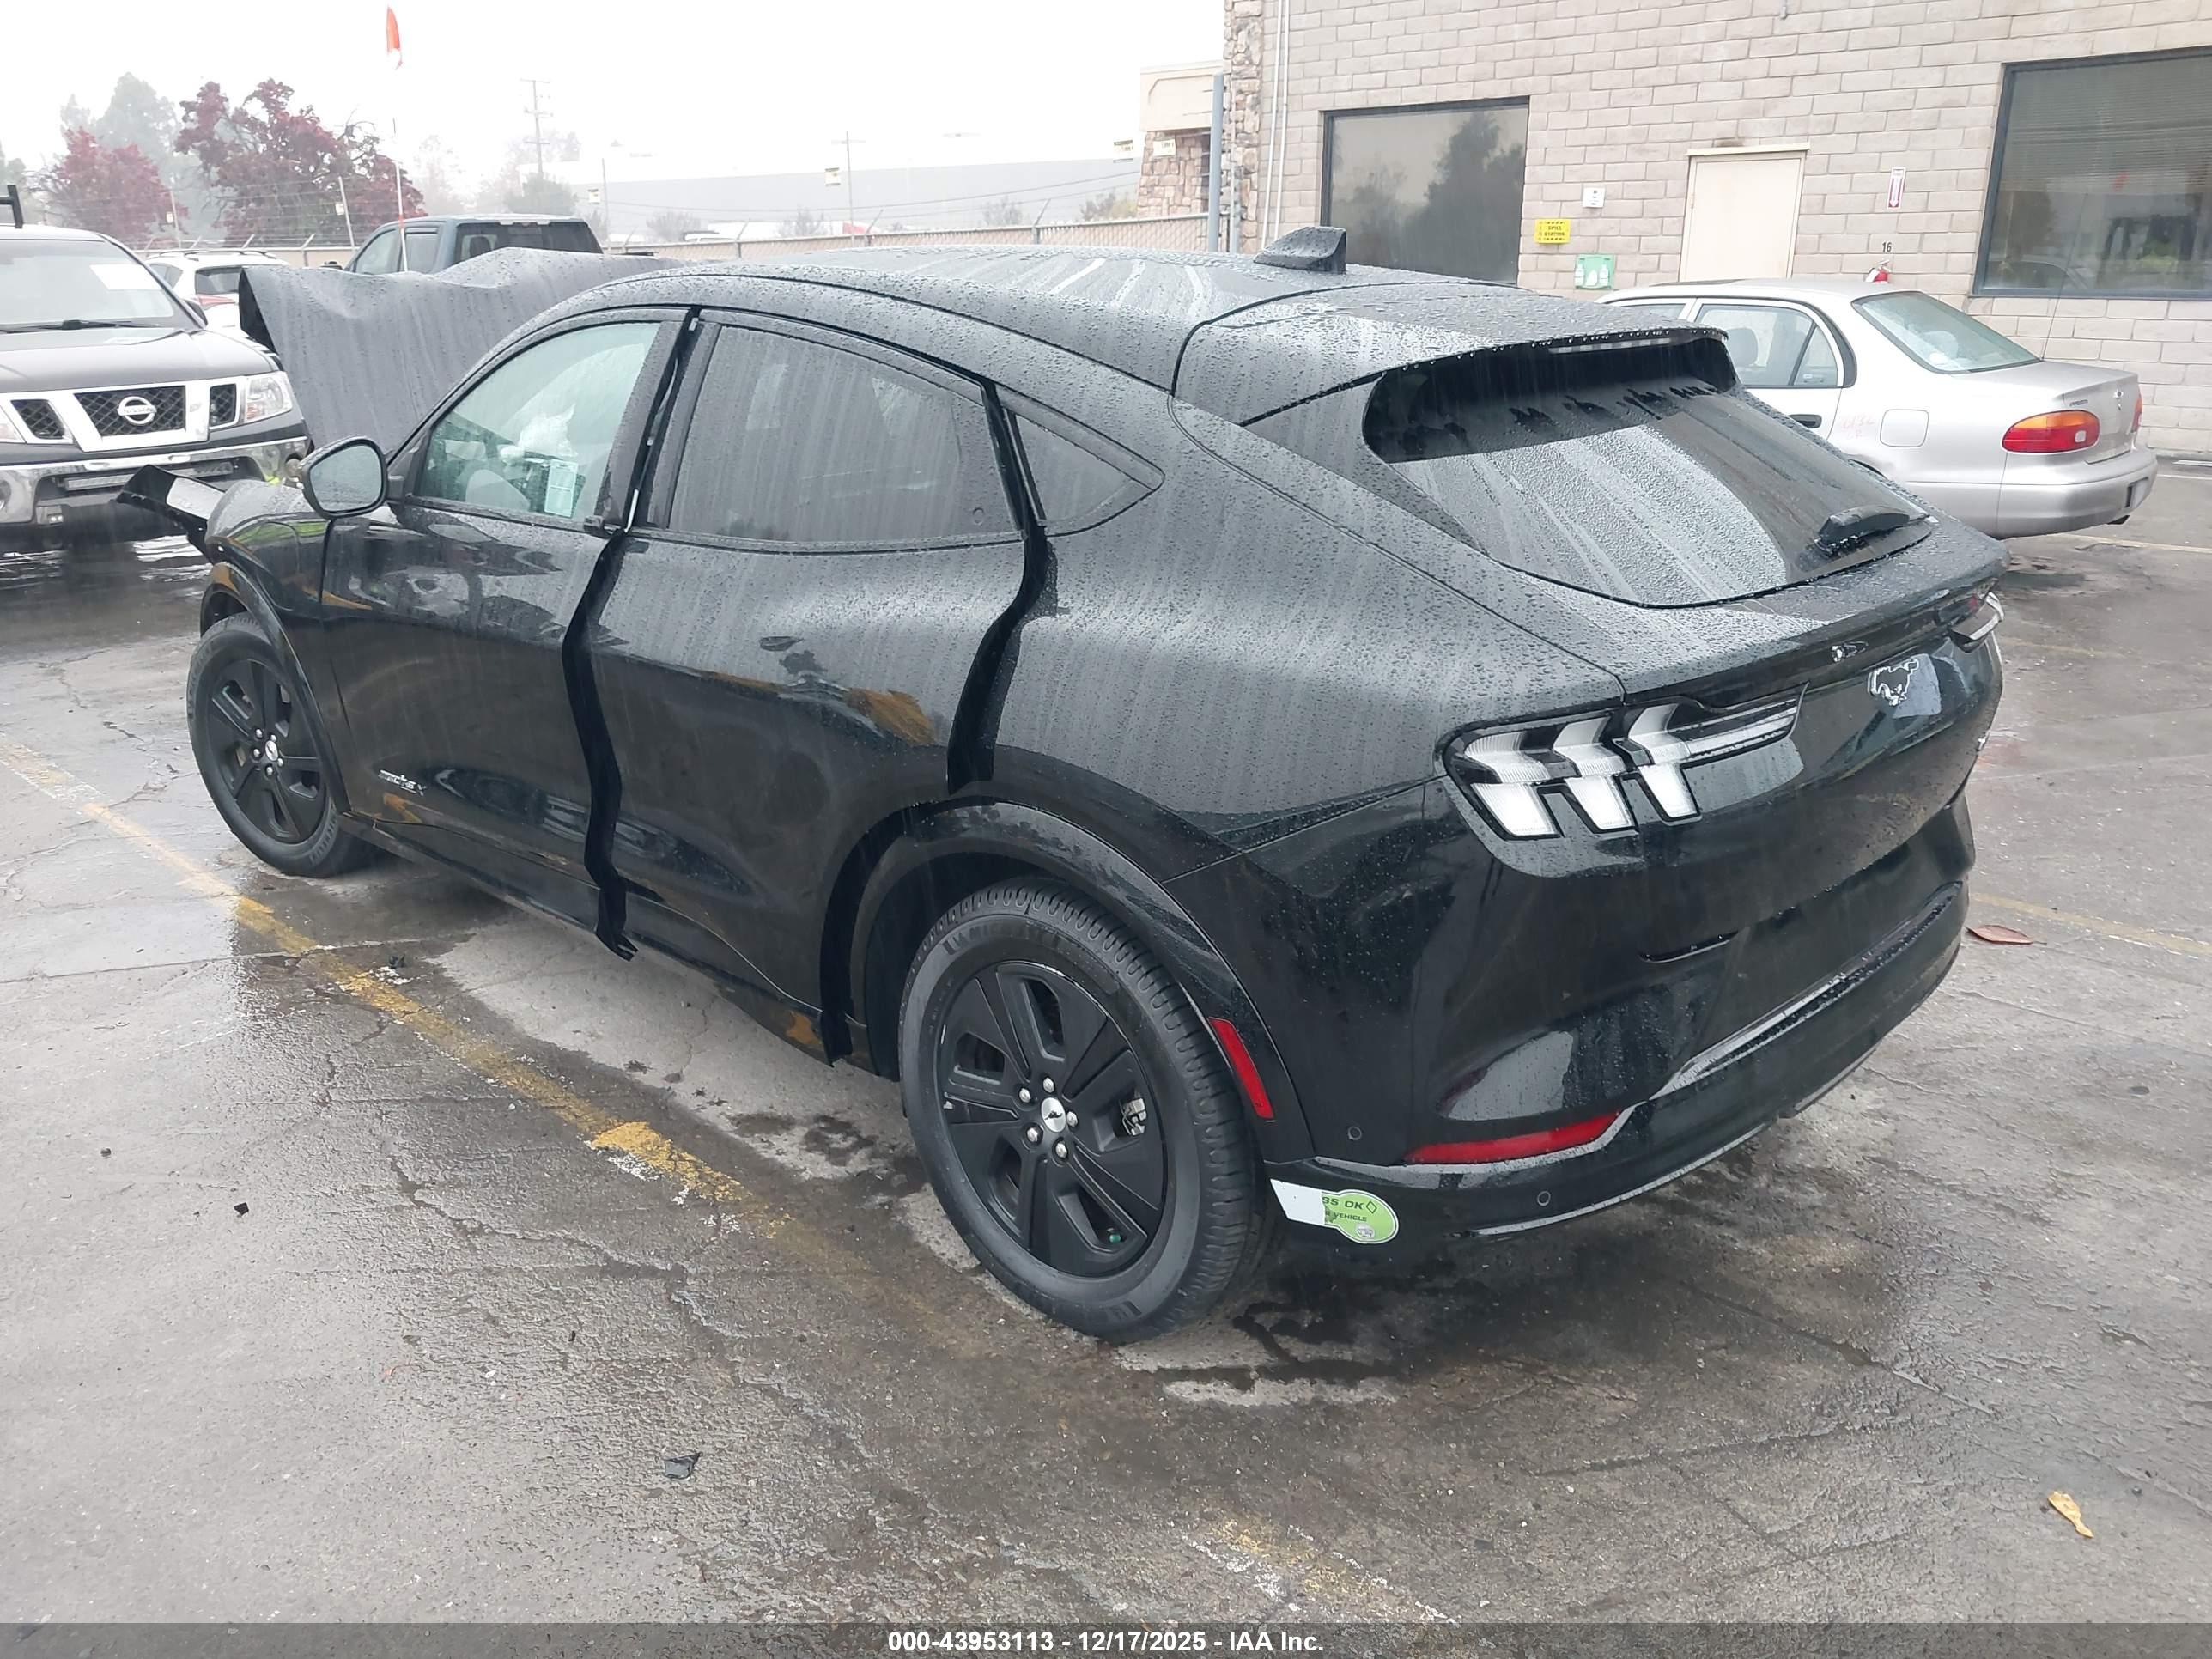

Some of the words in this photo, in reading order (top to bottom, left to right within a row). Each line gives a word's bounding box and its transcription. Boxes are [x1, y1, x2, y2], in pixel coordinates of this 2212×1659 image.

[1882, 241, 1893, 252] 16
[1345, 1200, 1364, 1210] OK
[1334, 1212, 1368, 1222] VEHICLE
